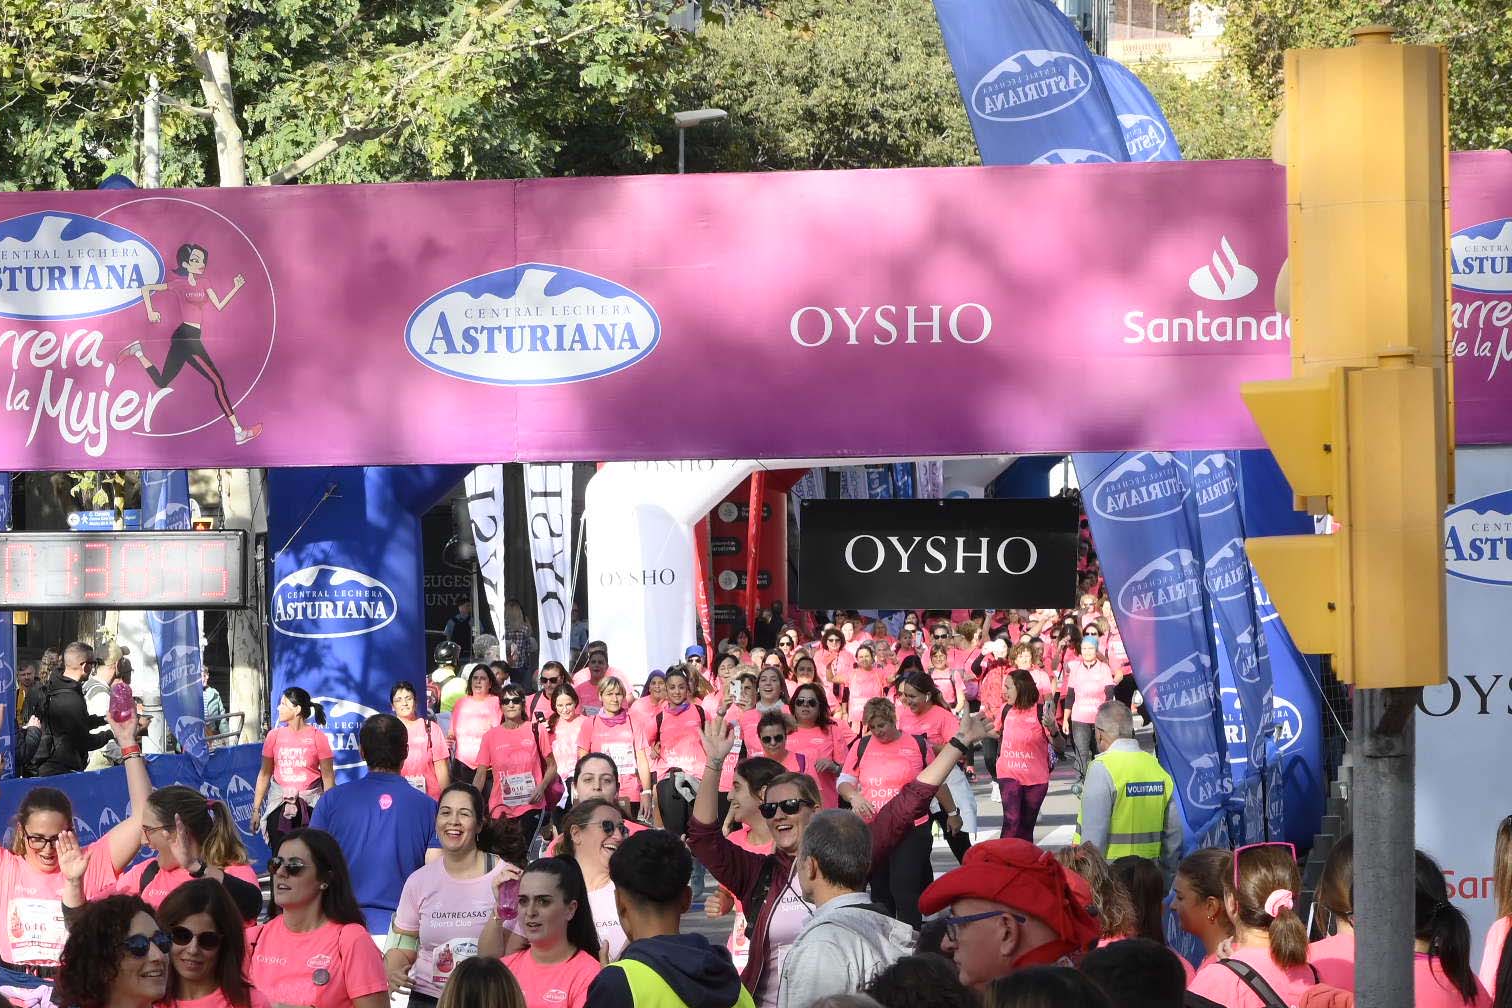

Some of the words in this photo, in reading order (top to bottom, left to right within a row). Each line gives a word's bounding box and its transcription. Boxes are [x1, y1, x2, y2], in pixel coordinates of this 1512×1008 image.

[68, 248, 139, 258] LECHERA
[464, 304, 545, 319] CENTRAL
[551, 303, 632, 317] LECHERA
[789, 302, 992, 348] OYSHO
[425, 311, 641, 356] ASTURIANA
[6, 370, 30, 411] la
[25, 363, 175, 457] Mujer
[845, 533, 1038, 576] OYSHO
[600, 568, 676, 586] OYSHO
[287, 589, 331, 599] CENTRAL
[334, 589, 383, 599] LECHERA
[275, 597, 388, 623] ASTURIANA
[1007, 760, 1029, 771] UMA
[869, 777, 882, 787] TU
[431, 910, 487, 920] CUATRECASAS
[256, 954, 287, 966] OYSHO
